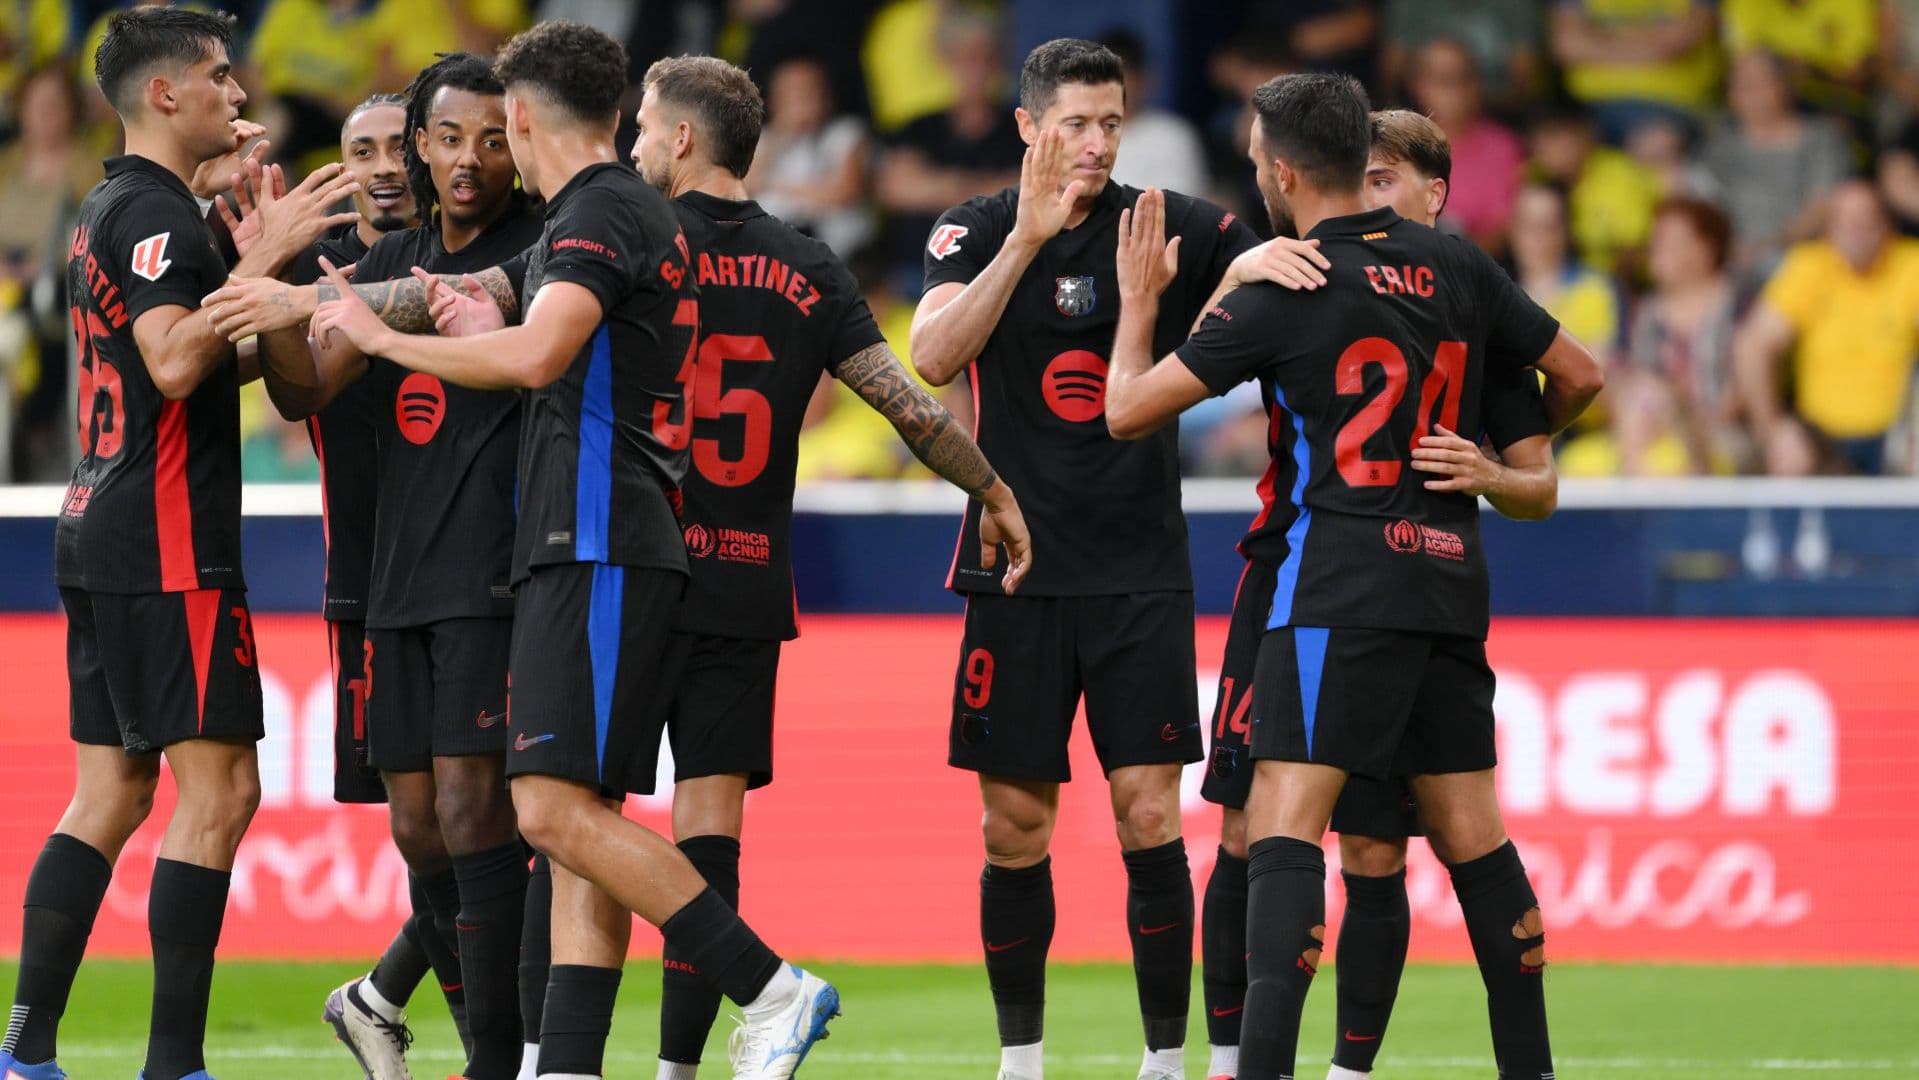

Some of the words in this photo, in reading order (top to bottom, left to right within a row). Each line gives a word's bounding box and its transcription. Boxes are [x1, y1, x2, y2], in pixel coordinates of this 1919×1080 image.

[694, 251, 822, 317] ARTINEZ
[1364, 265, 1435, 298] ERIC
[692, 334, 776, 487] 5
[1335, 337, 1468, 487] 24
[718, 528, 769, 546] UNHCR
[718, 542, 769, 559] ACNUR
[1425, 537, 1464, 555] ACNUR
[964, 648, 995, 709] 9
[1216, 676, 1254, 746] 14
